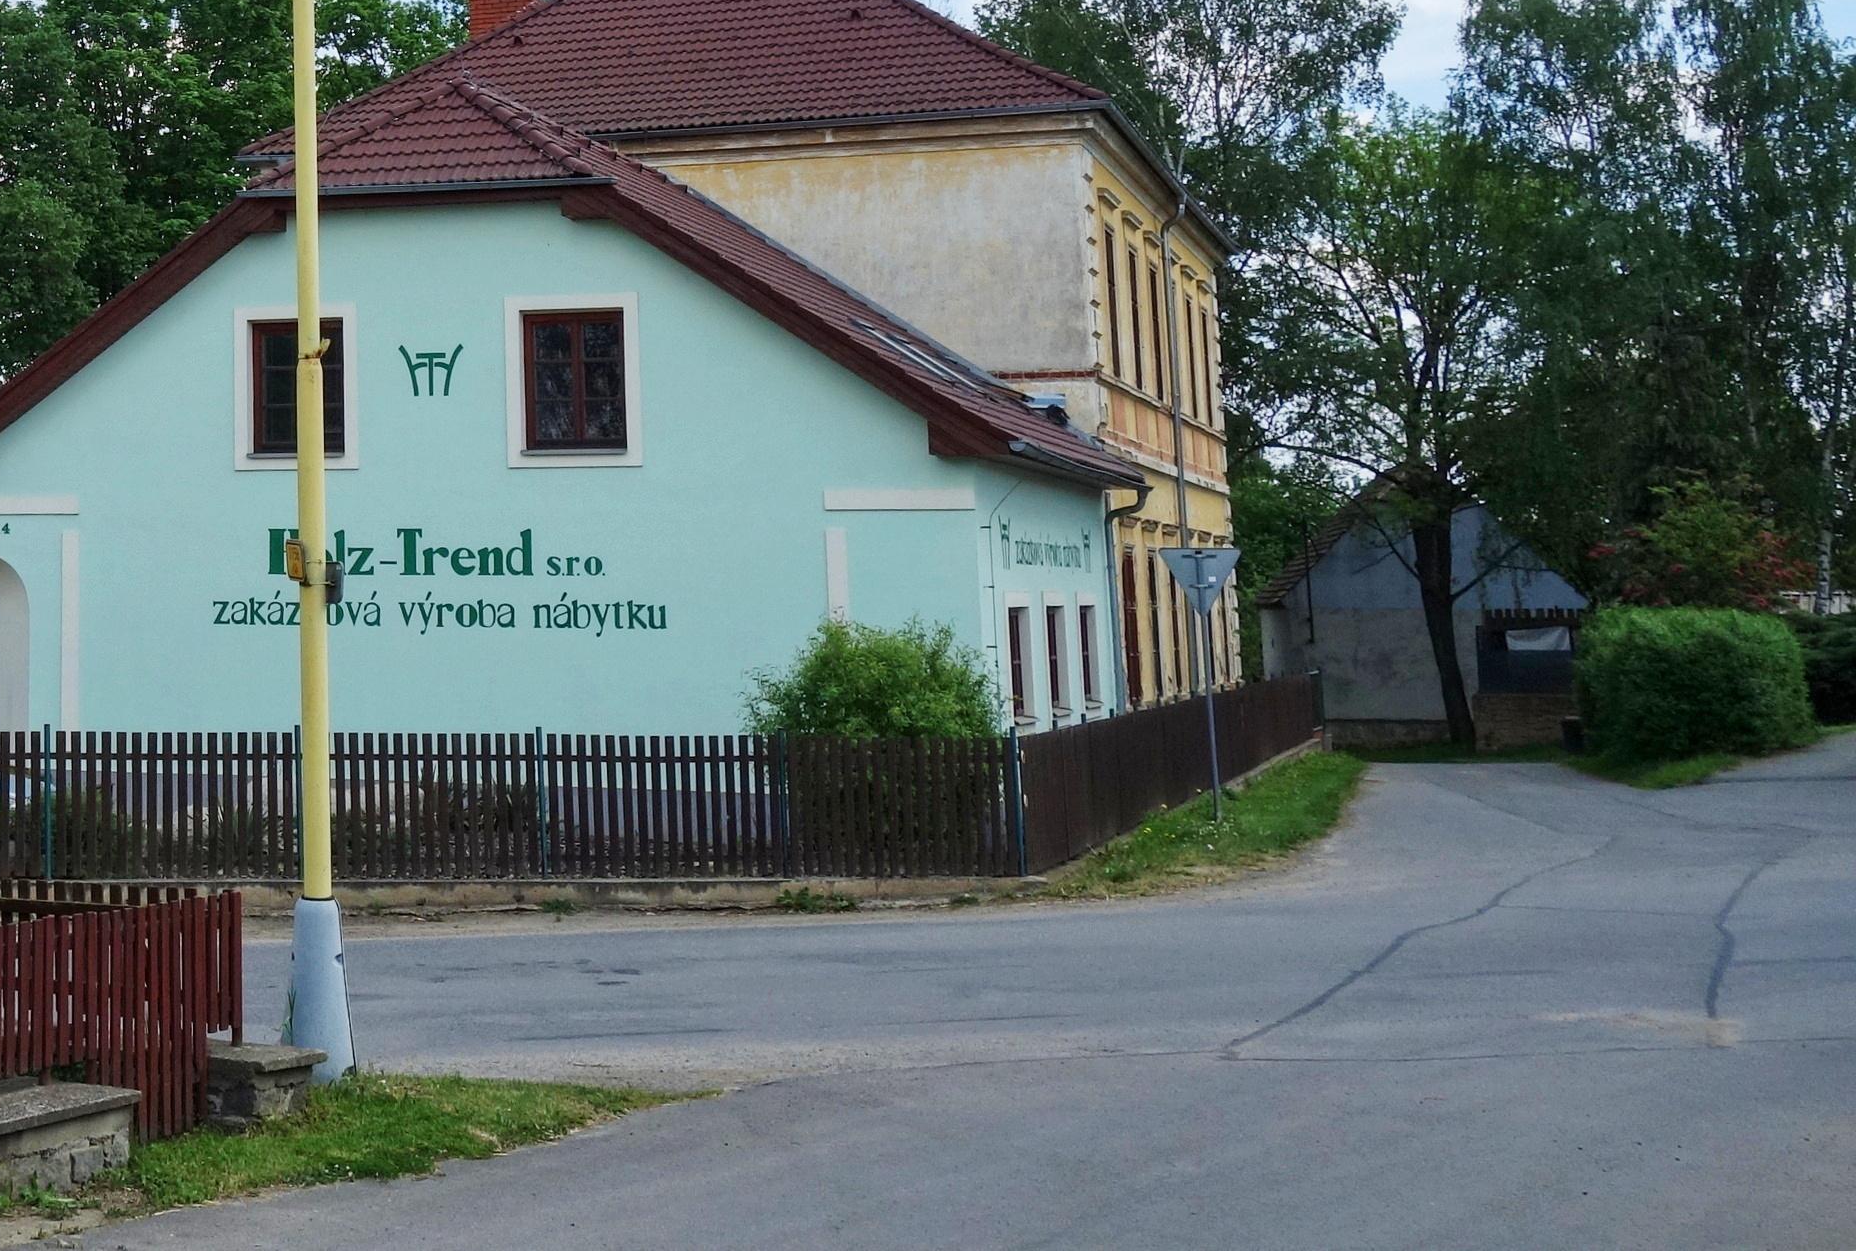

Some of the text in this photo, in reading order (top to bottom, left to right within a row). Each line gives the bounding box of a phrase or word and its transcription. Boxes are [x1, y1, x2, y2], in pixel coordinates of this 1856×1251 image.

[267, 528, 534, 576] Hlz-Trend
[546, 556, 606, 576] s.r.o.
[212, 590, 667, 638] zakázová výroba nábytku
